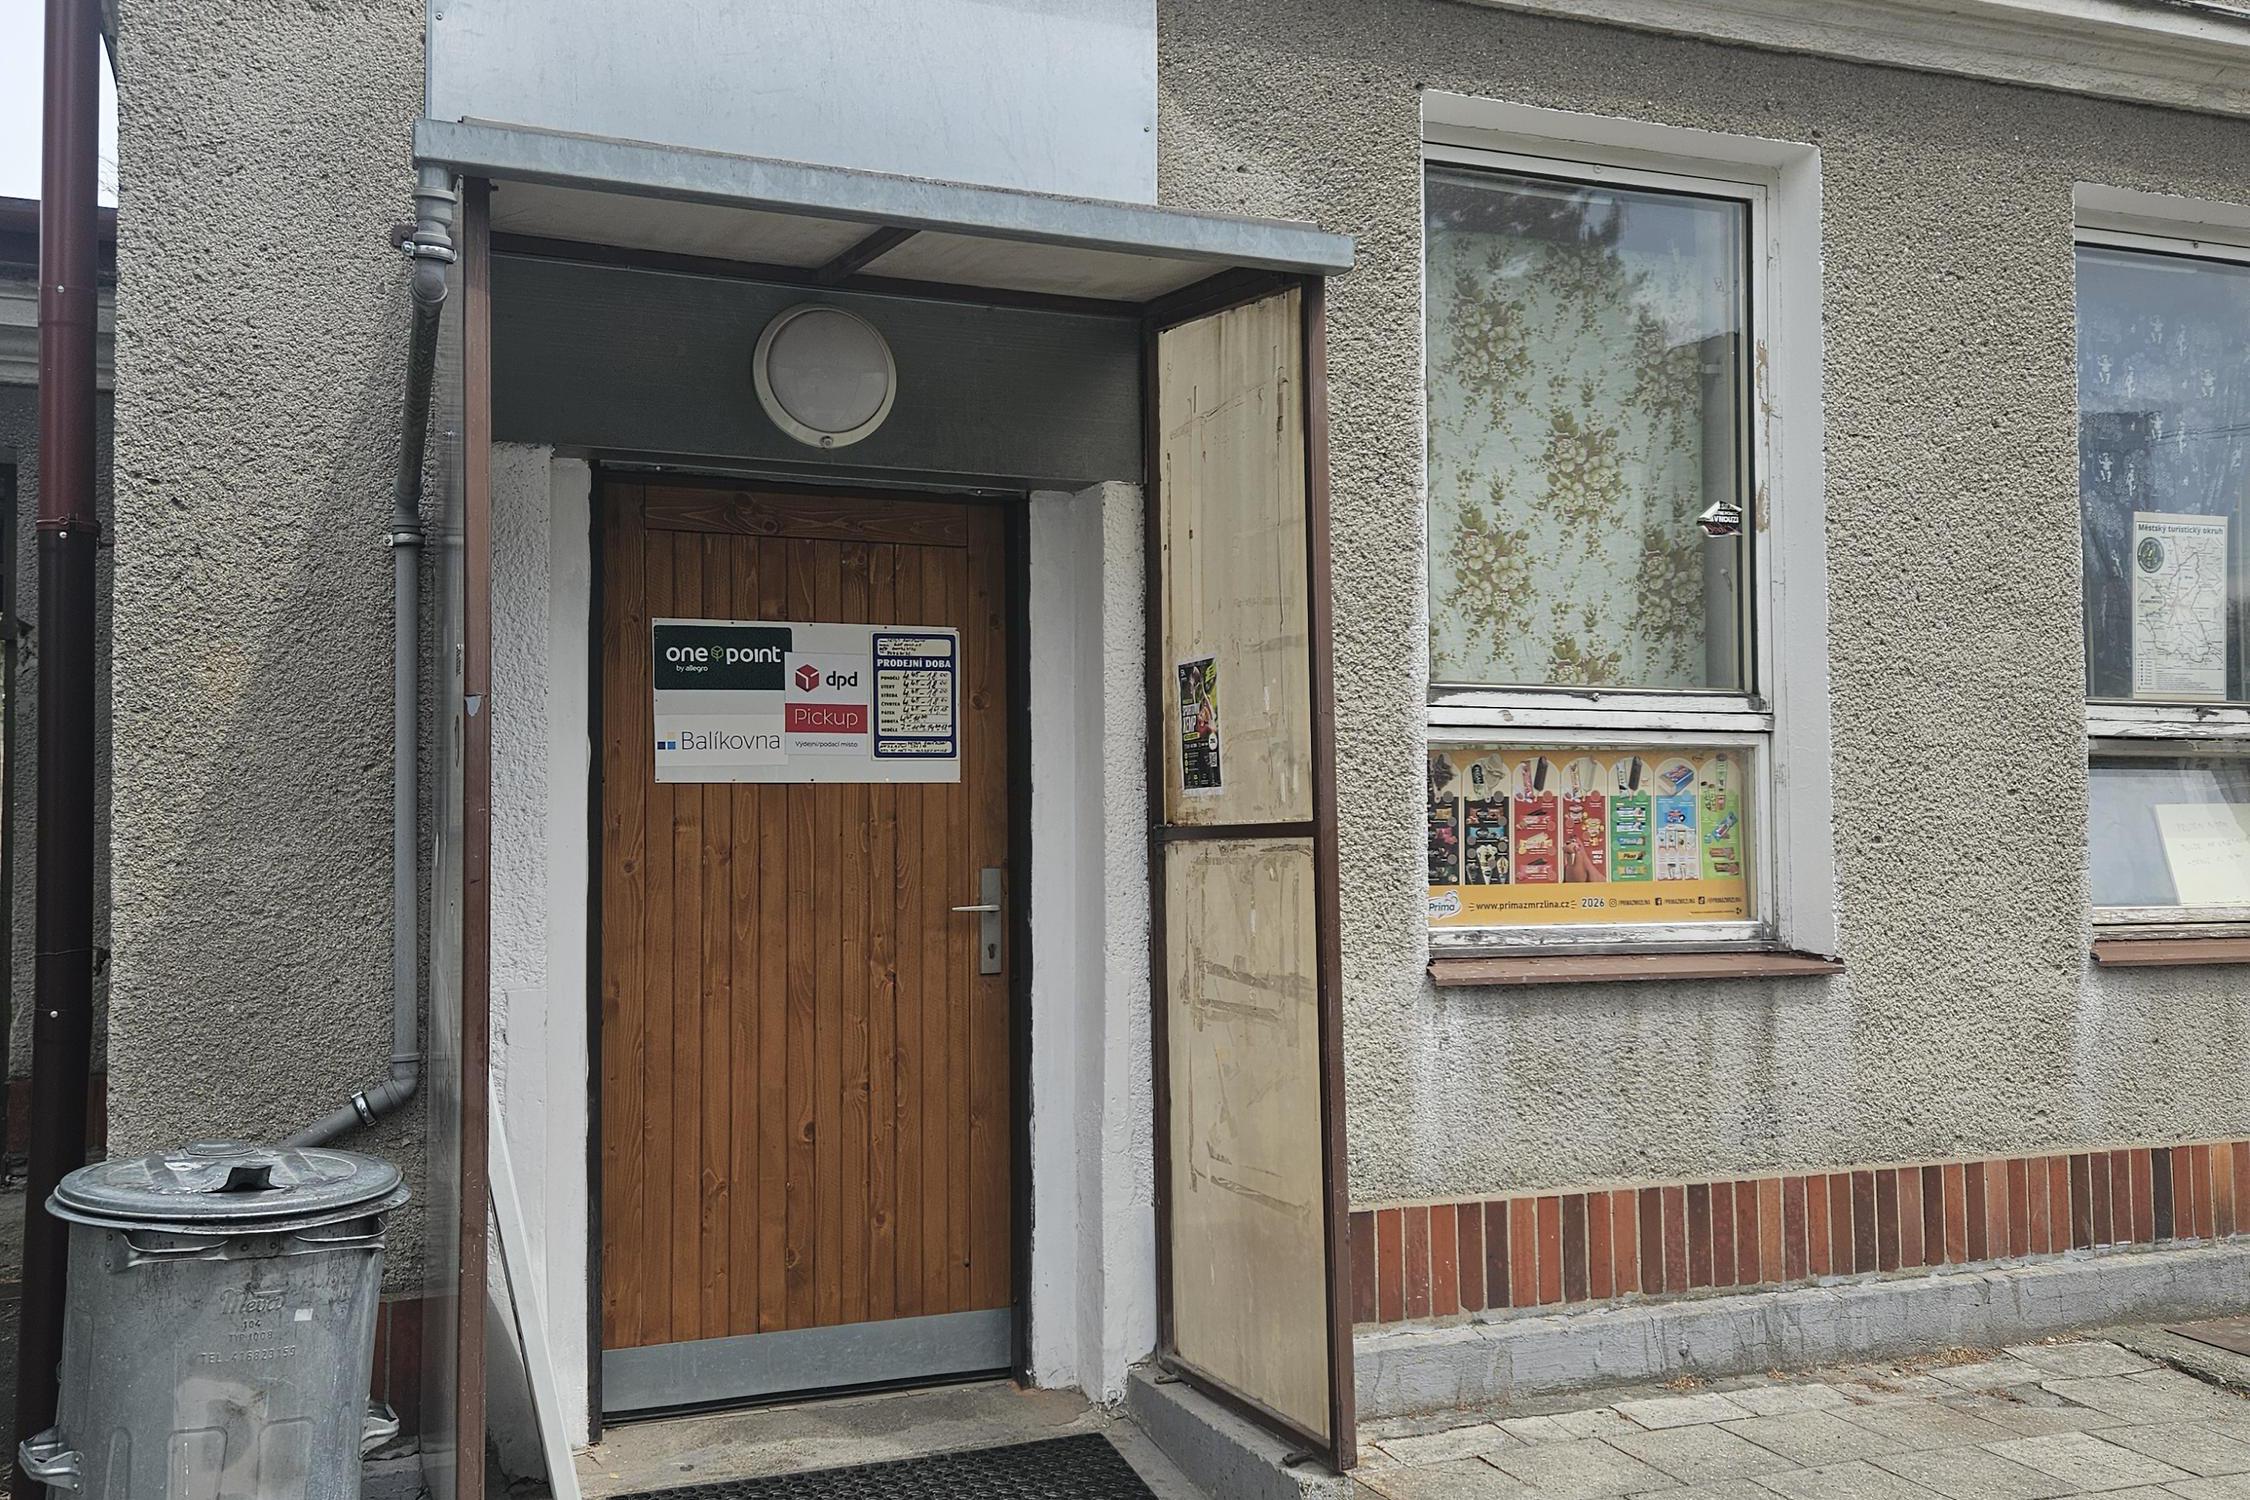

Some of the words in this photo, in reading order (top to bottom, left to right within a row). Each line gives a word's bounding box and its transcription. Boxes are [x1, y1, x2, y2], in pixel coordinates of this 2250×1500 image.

[2138, 523, 2167, 534] Městský
[2168, 526, 2201, 536] turistický
[666, 646, 709, 662] one
[726, 645, 782, 665] point
[676, 665, 685, 673] by
[685, 665, 709, 673] allegro
[877, 657, 923, 668] PRODEJNÍ
[925, 659, 951, 668] DOBA
[825, 670, 858, 691] dpd
[794, 708, 858, 729] Pickup
[681, 731, 781, 750] Balíkovna
[1428, 902, 1455, 912] Prima
[1476, 900, 1570, 911] www.primazmrzlina.cz
[1581, 898, 1605, 908] 2026
